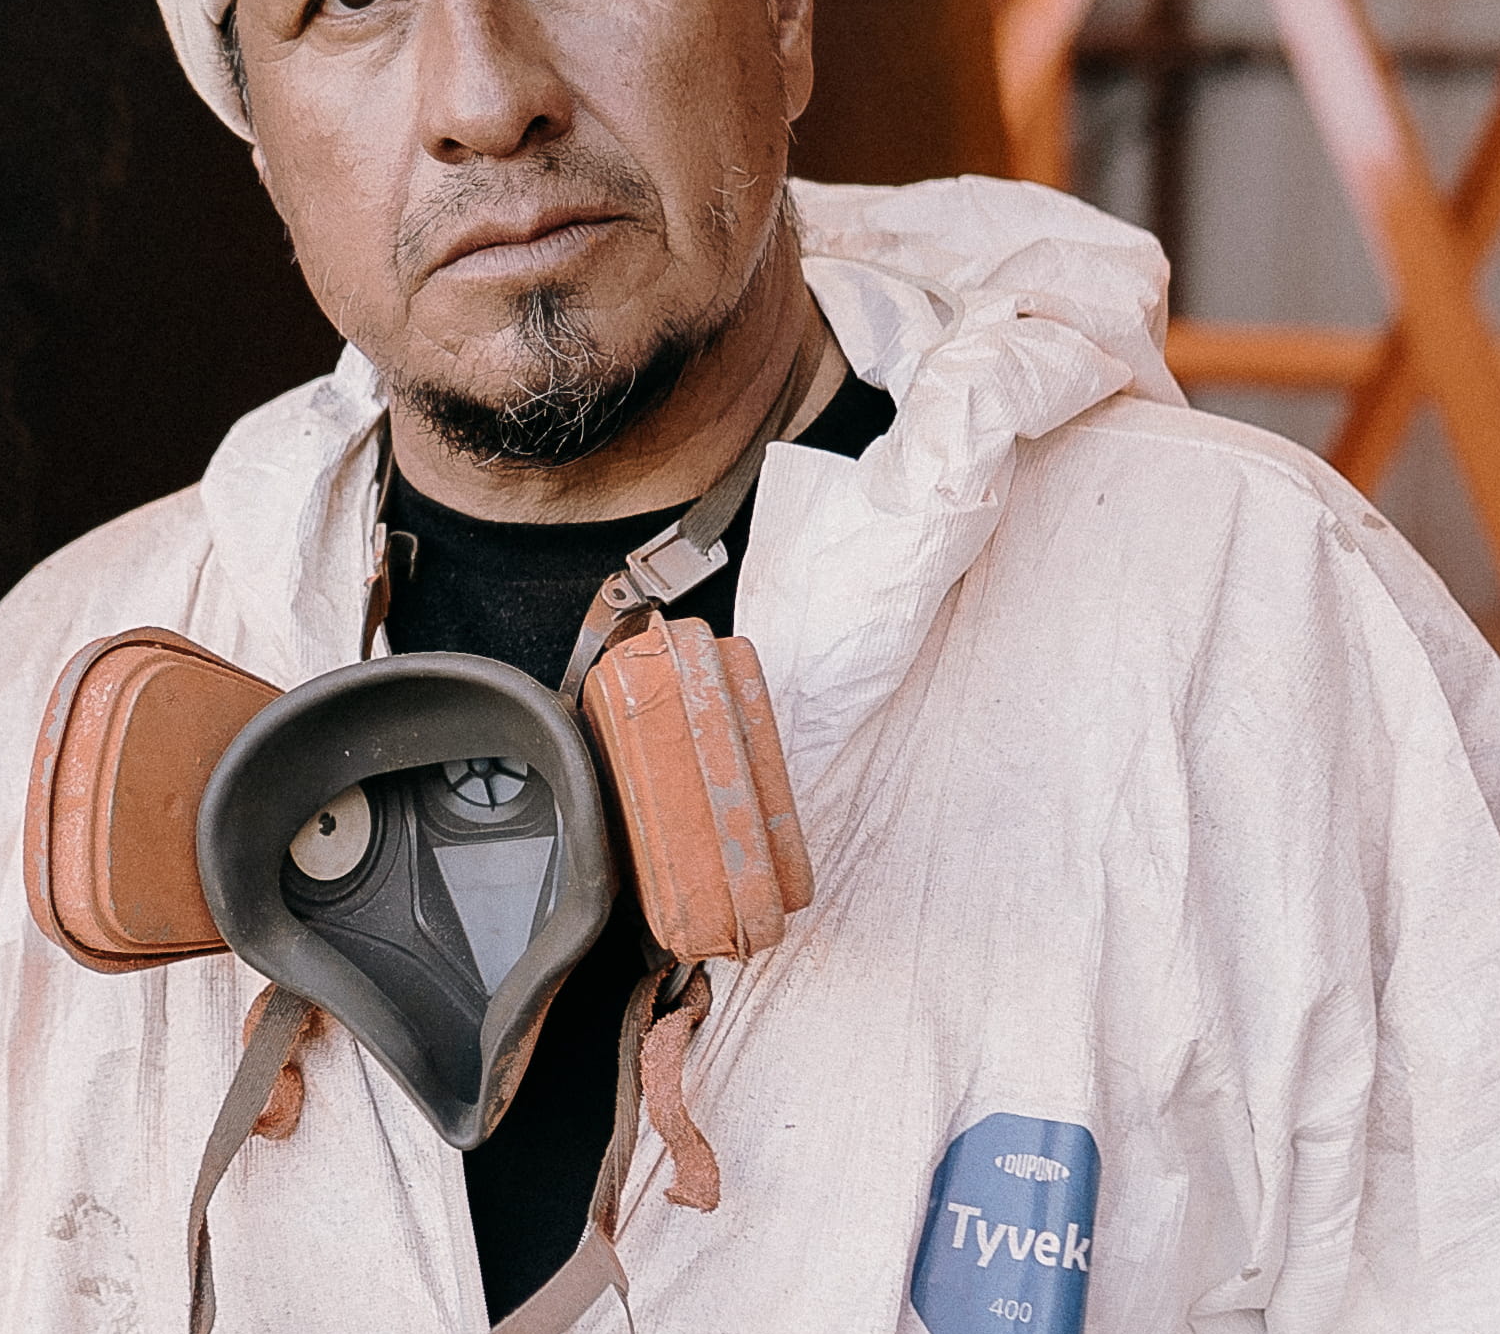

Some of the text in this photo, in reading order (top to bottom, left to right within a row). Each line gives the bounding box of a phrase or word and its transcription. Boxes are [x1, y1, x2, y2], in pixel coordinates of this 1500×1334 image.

[1004, 1154, 1061, 1181] DUPONT
[947, 1202, 1091, 1271] Tyvek
[989, 1297, 1032, 1323] 400
